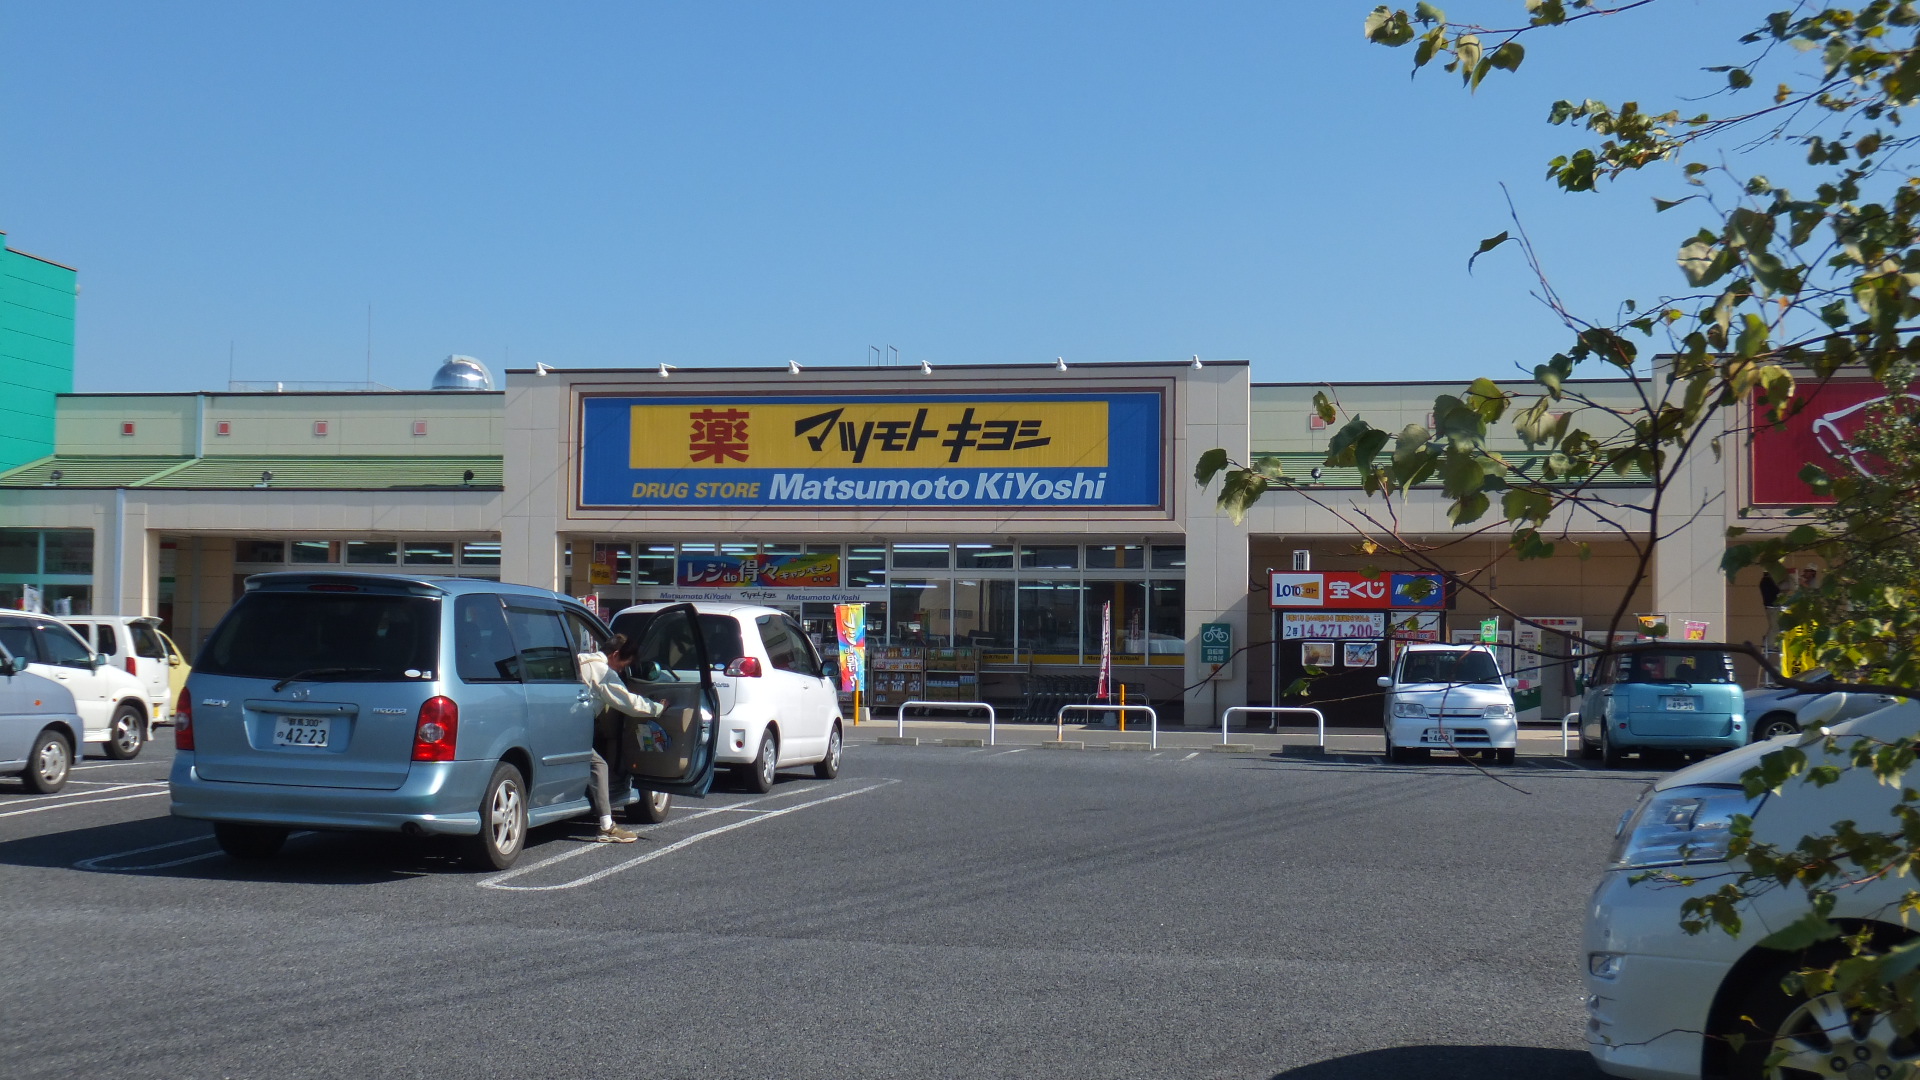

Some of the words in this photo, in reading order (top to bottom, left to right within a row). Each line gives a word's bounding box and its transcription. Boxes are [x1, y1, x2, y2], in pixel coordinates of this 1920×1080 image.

[690, 408, 749, 464] 薬
[795, 407, 1051, 463] マツモトキヨシ
[632, 482, 688, 498] DRUG
[694, 482, 760, 498] STORE
[769, 472, 970, 500] Matsumoto
[974, 472, 1107, 500] KiYoshi
[660, 592, 703, 600] Matsumoto
[704, 592, 732, 600] KiYoshi
[786, 593, 832, 601] Matsumoto
[1276, 583, 1300, 597] LOTO
[1328, 580, 1385, 599] 宝くじ
[286, 727, 326, 745] 42-23
